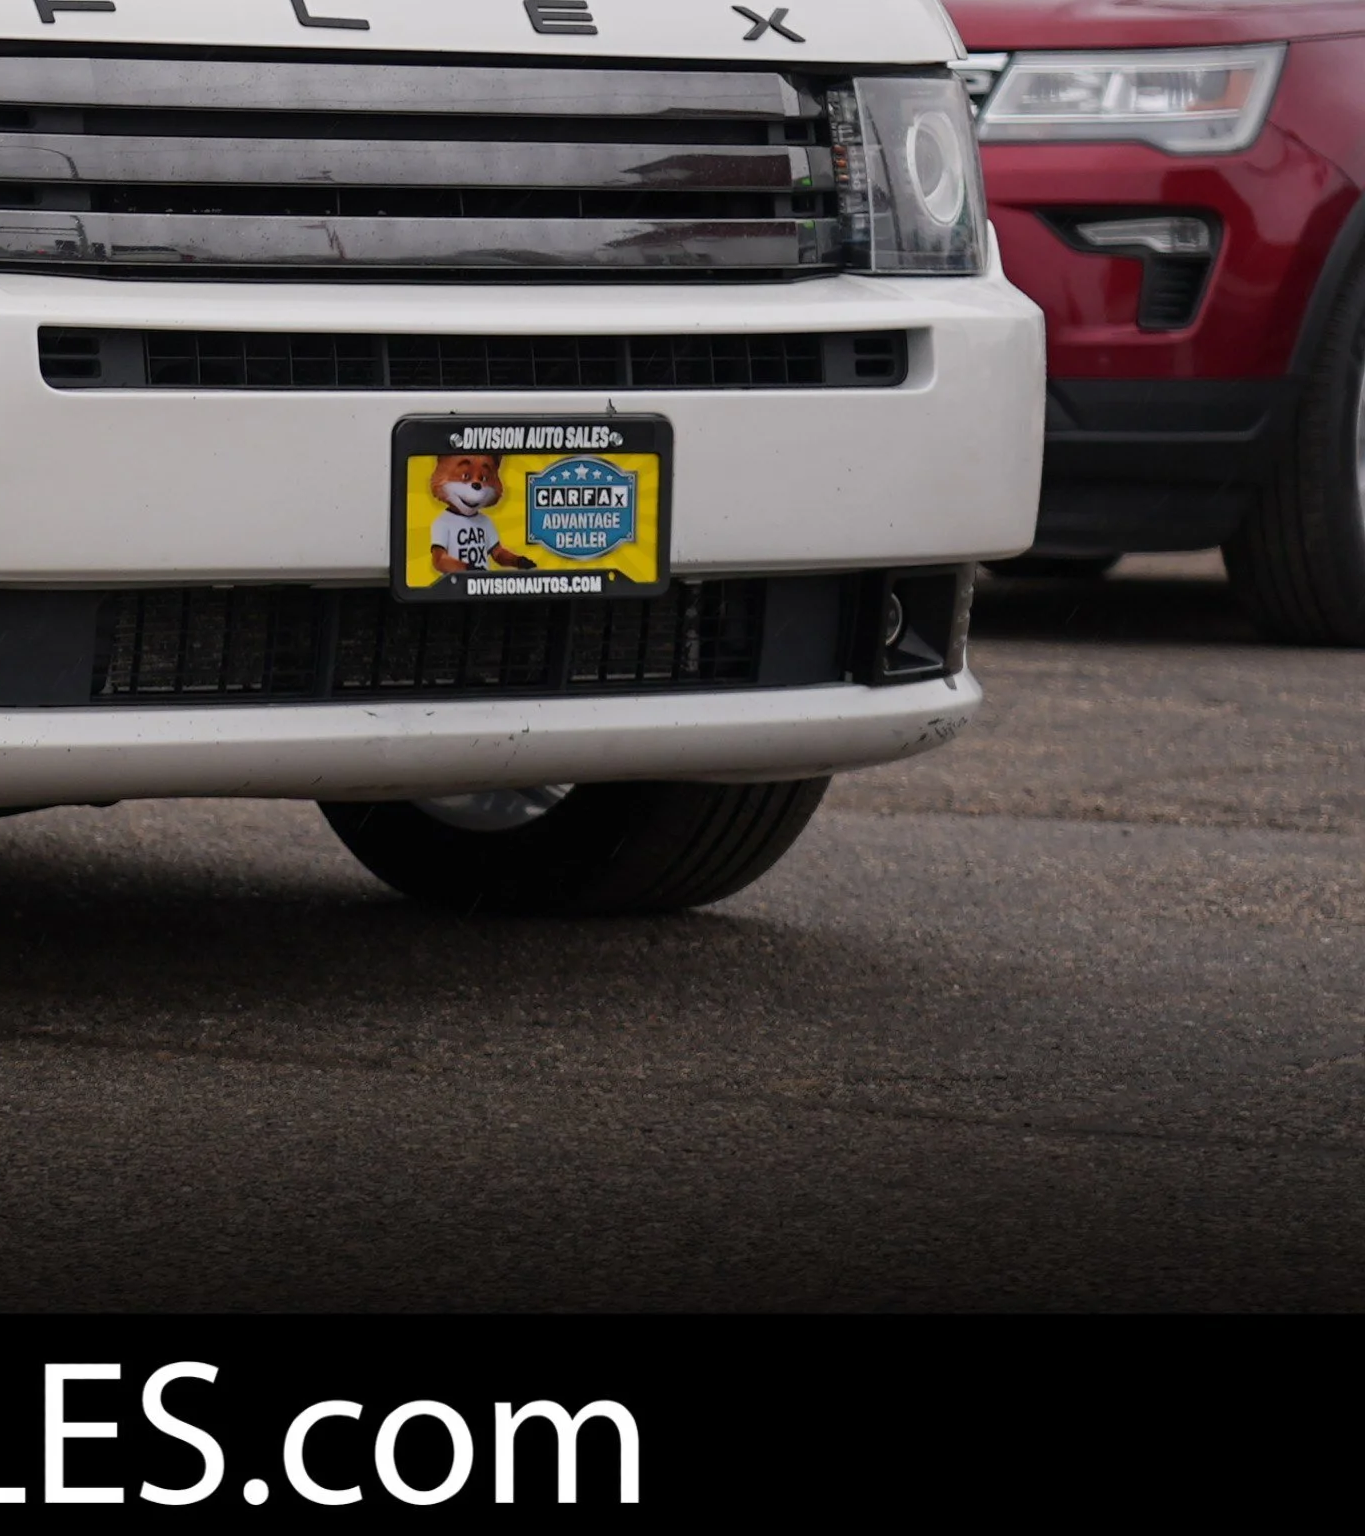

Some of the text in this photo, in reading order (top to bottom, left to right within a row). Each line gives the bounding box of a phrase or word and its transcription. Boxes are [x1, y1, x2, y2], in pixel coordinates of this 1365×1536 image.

[463, 426, 610, 450] DIVISION AUTO SALES
[536, 487, 628, 508] CARFAX
[542, 512, 621, 530] ADVANTAGE
[457, 527, 486, 545] CAR
[555, 531, 607, 549] DEALER
[458, 545, 487, 565] FOX
[467, 575, 602, 595] DIVISIONAUTOS.COM
